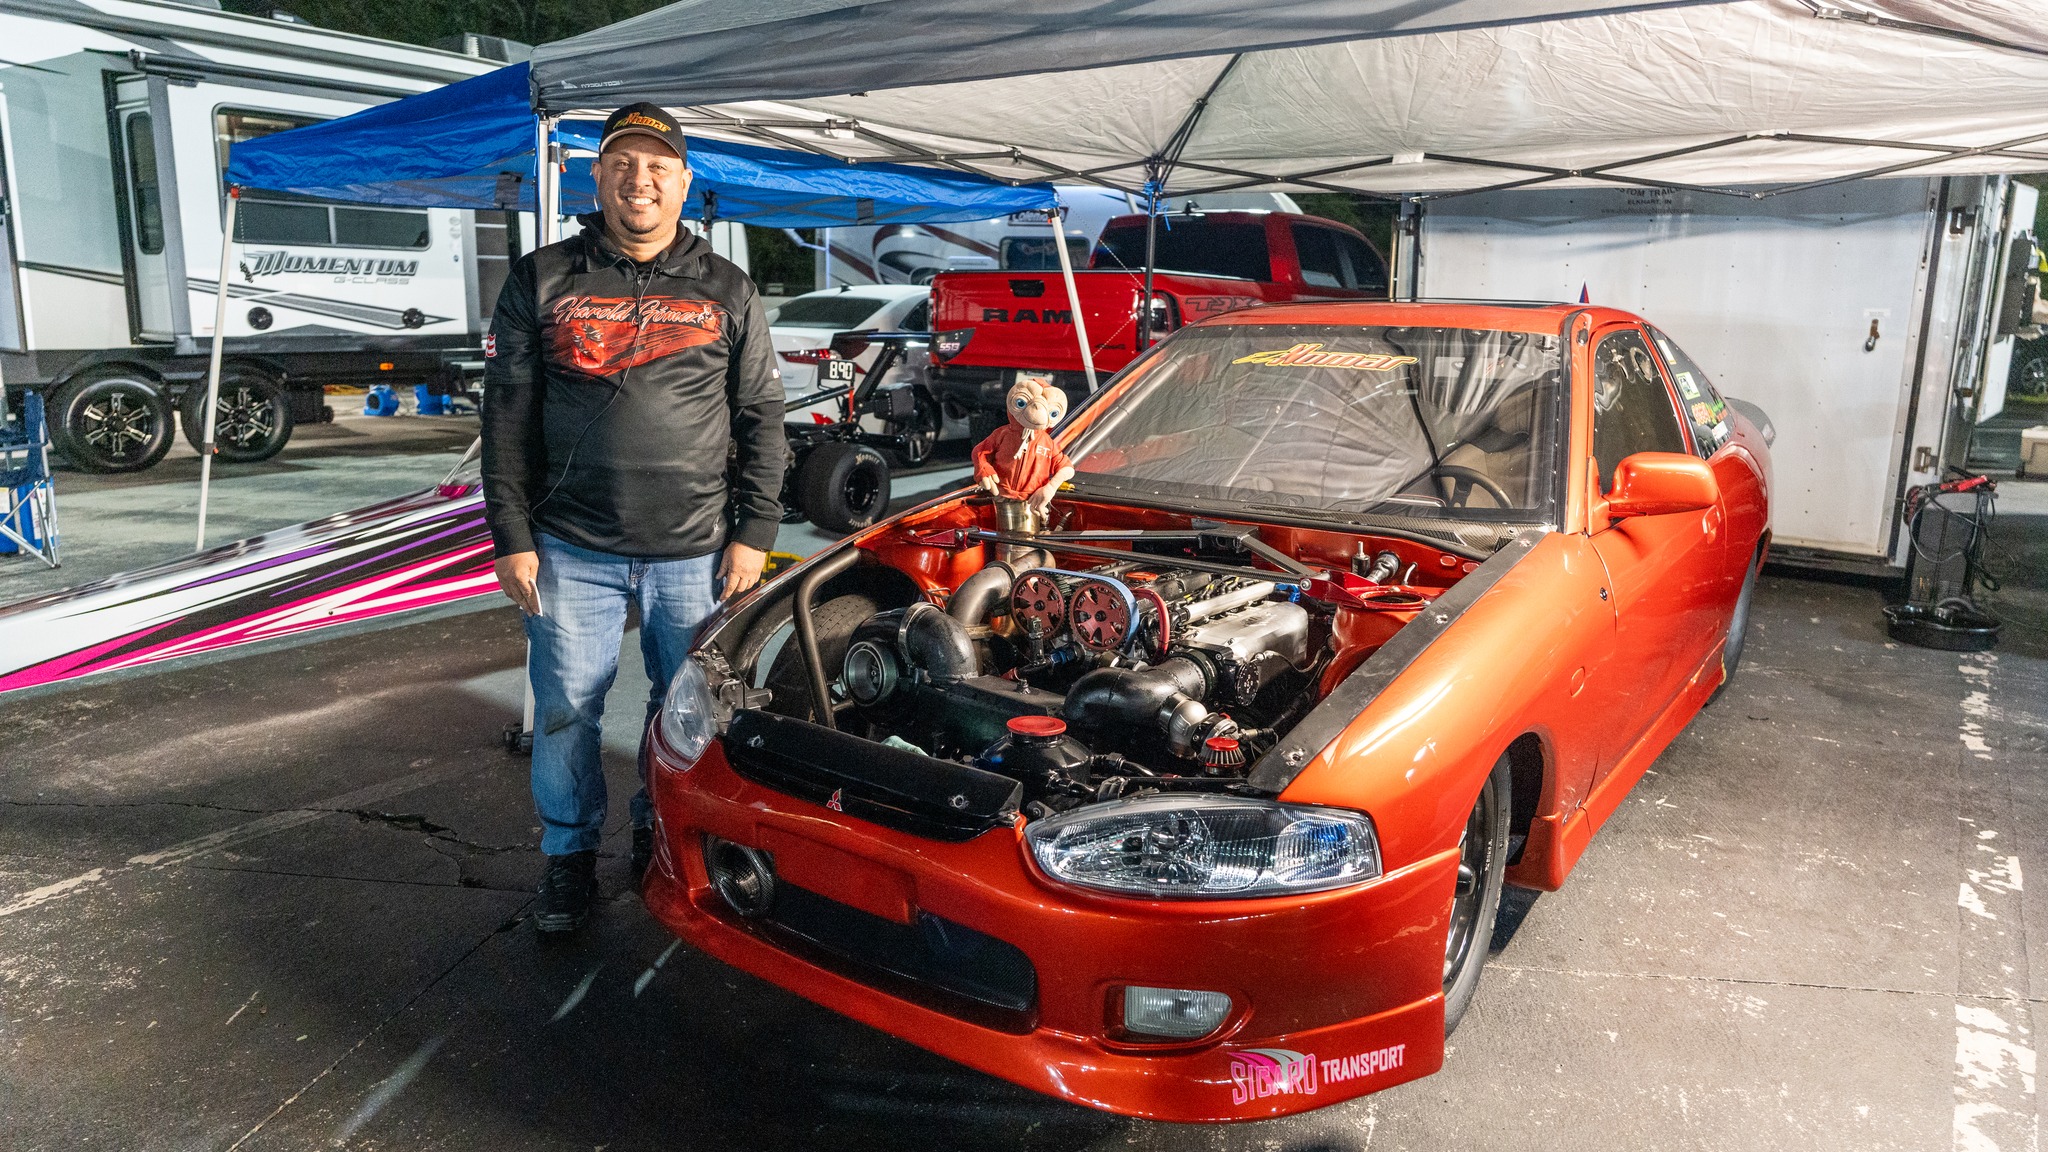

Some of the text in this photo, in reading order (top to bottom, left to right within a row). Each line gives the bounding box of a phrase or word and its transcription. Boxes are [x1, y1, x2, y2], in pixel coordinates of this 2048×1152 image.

[246, 251, 419, 276] MOMENTUM
[334, 276, 410, 285] G-CLASS
[983, 309, 1073, 324] RAM
[829, 361, 853, 380] 8.90
[1321, 1044, 1406, 1084] TRANSPORT
